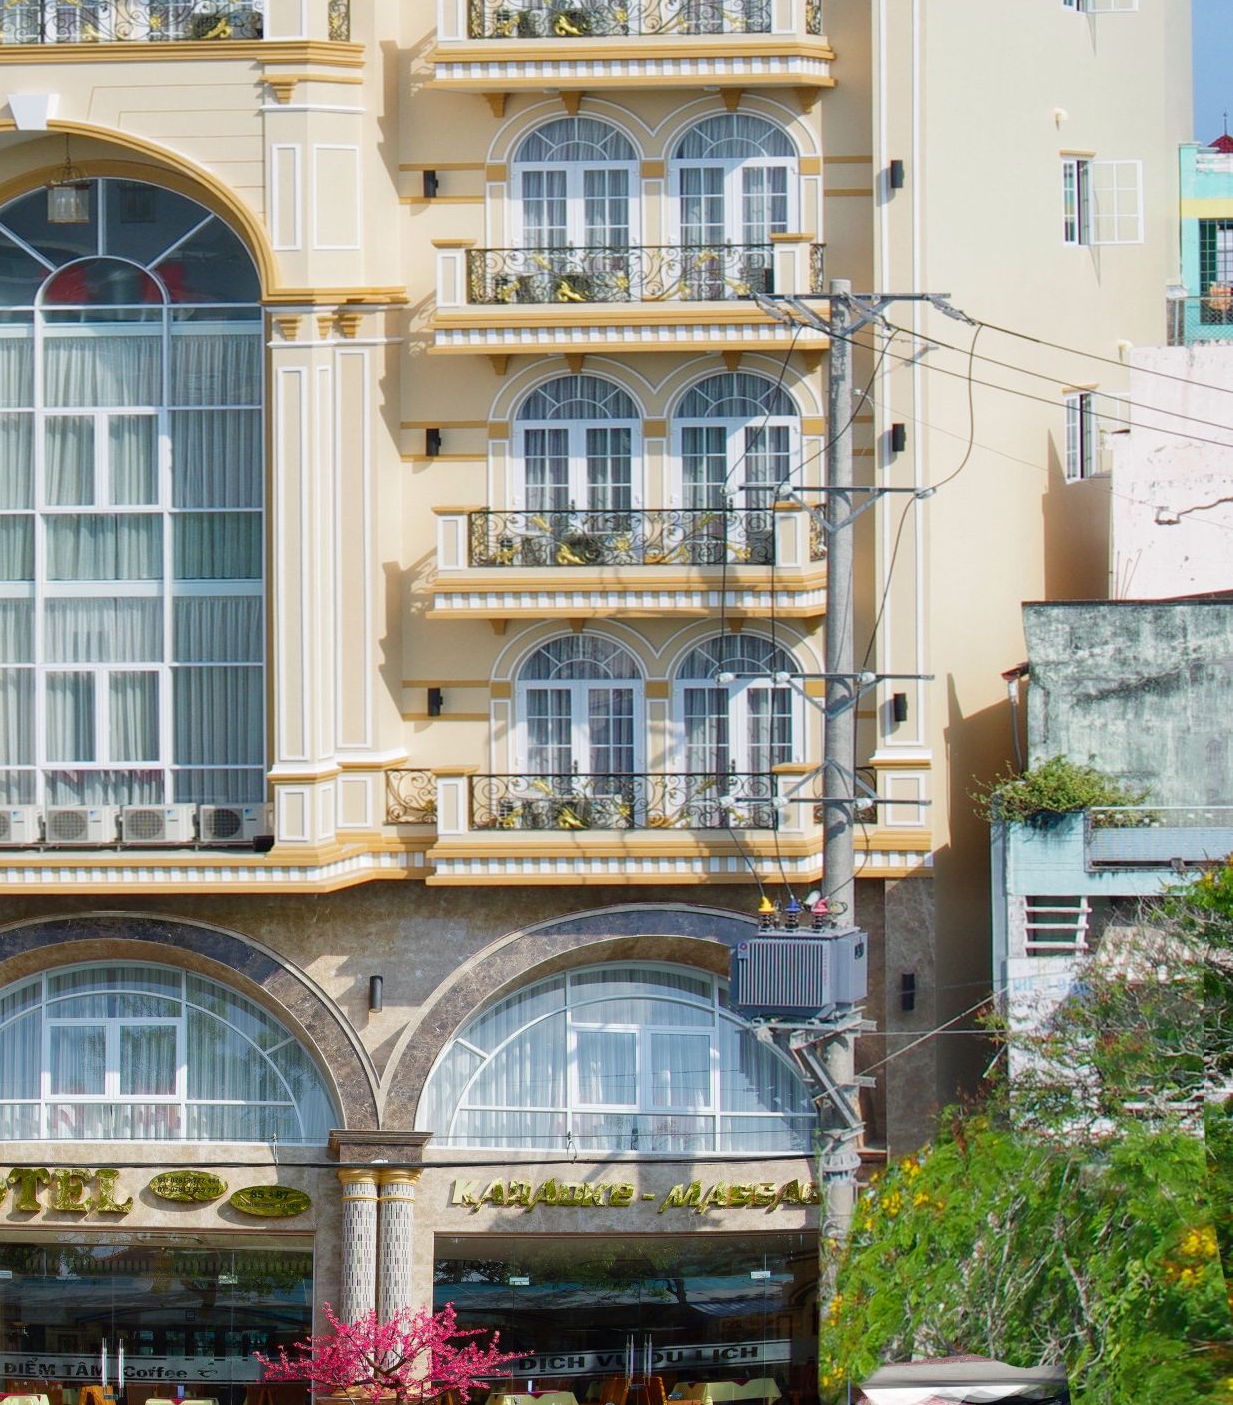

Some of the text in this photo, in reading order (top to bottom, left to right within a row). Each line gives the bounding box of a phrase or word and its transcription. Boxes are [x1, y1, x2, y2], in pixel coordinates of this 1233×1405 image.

[657, 1178, 821, 1214] MASSAG
[4, 1357, 188, 1379] ĐIỂM TÂM Coffee
[518, 1356, 585, 1373] DỊCH
[695, 1346, 758, 1364] LỊCH
